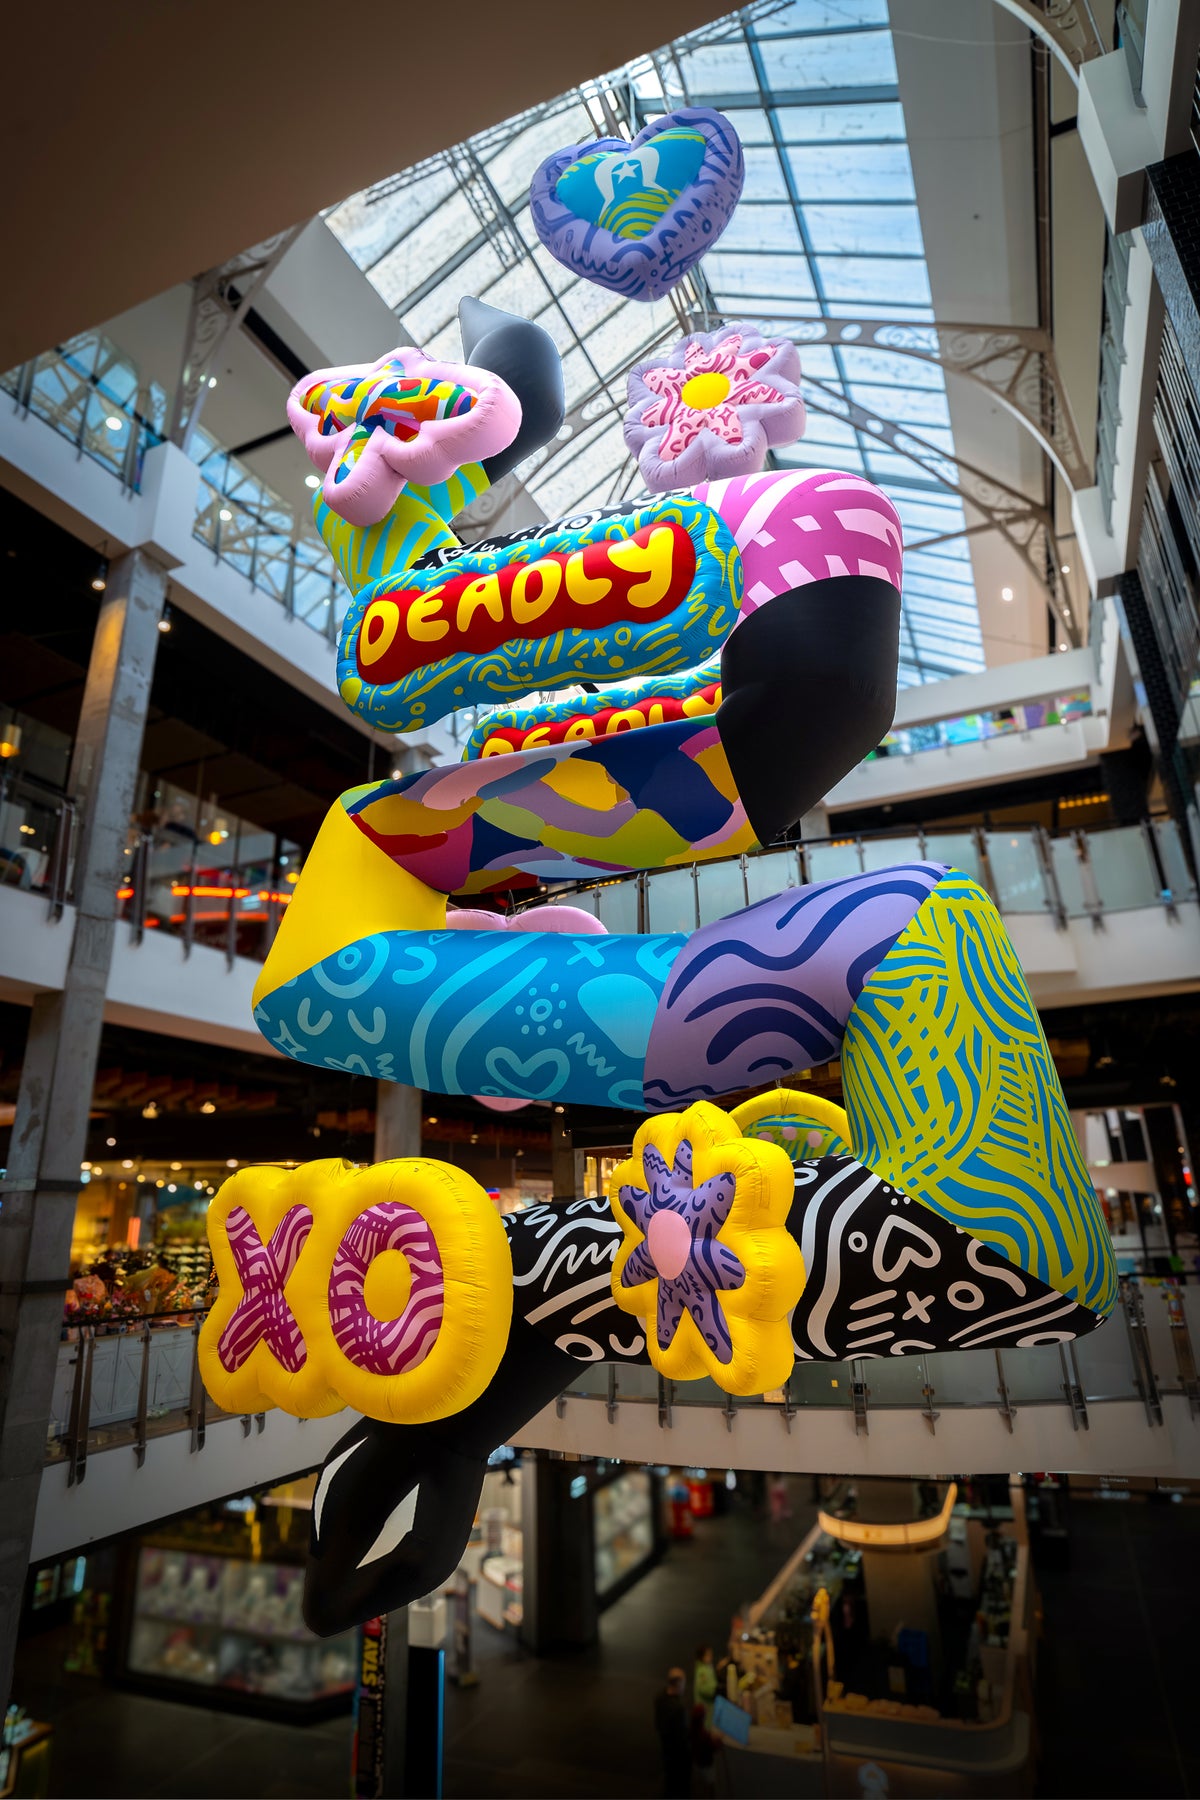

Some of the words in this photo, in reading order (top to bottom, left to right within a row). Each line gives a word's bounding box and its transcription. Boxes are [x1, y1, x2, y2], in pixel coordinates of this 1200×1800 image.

[360, 527, 675, 667] DEADLY
[217, 1201, 445, 1376] XO
[361, 1636, 379, 1687] STAY
